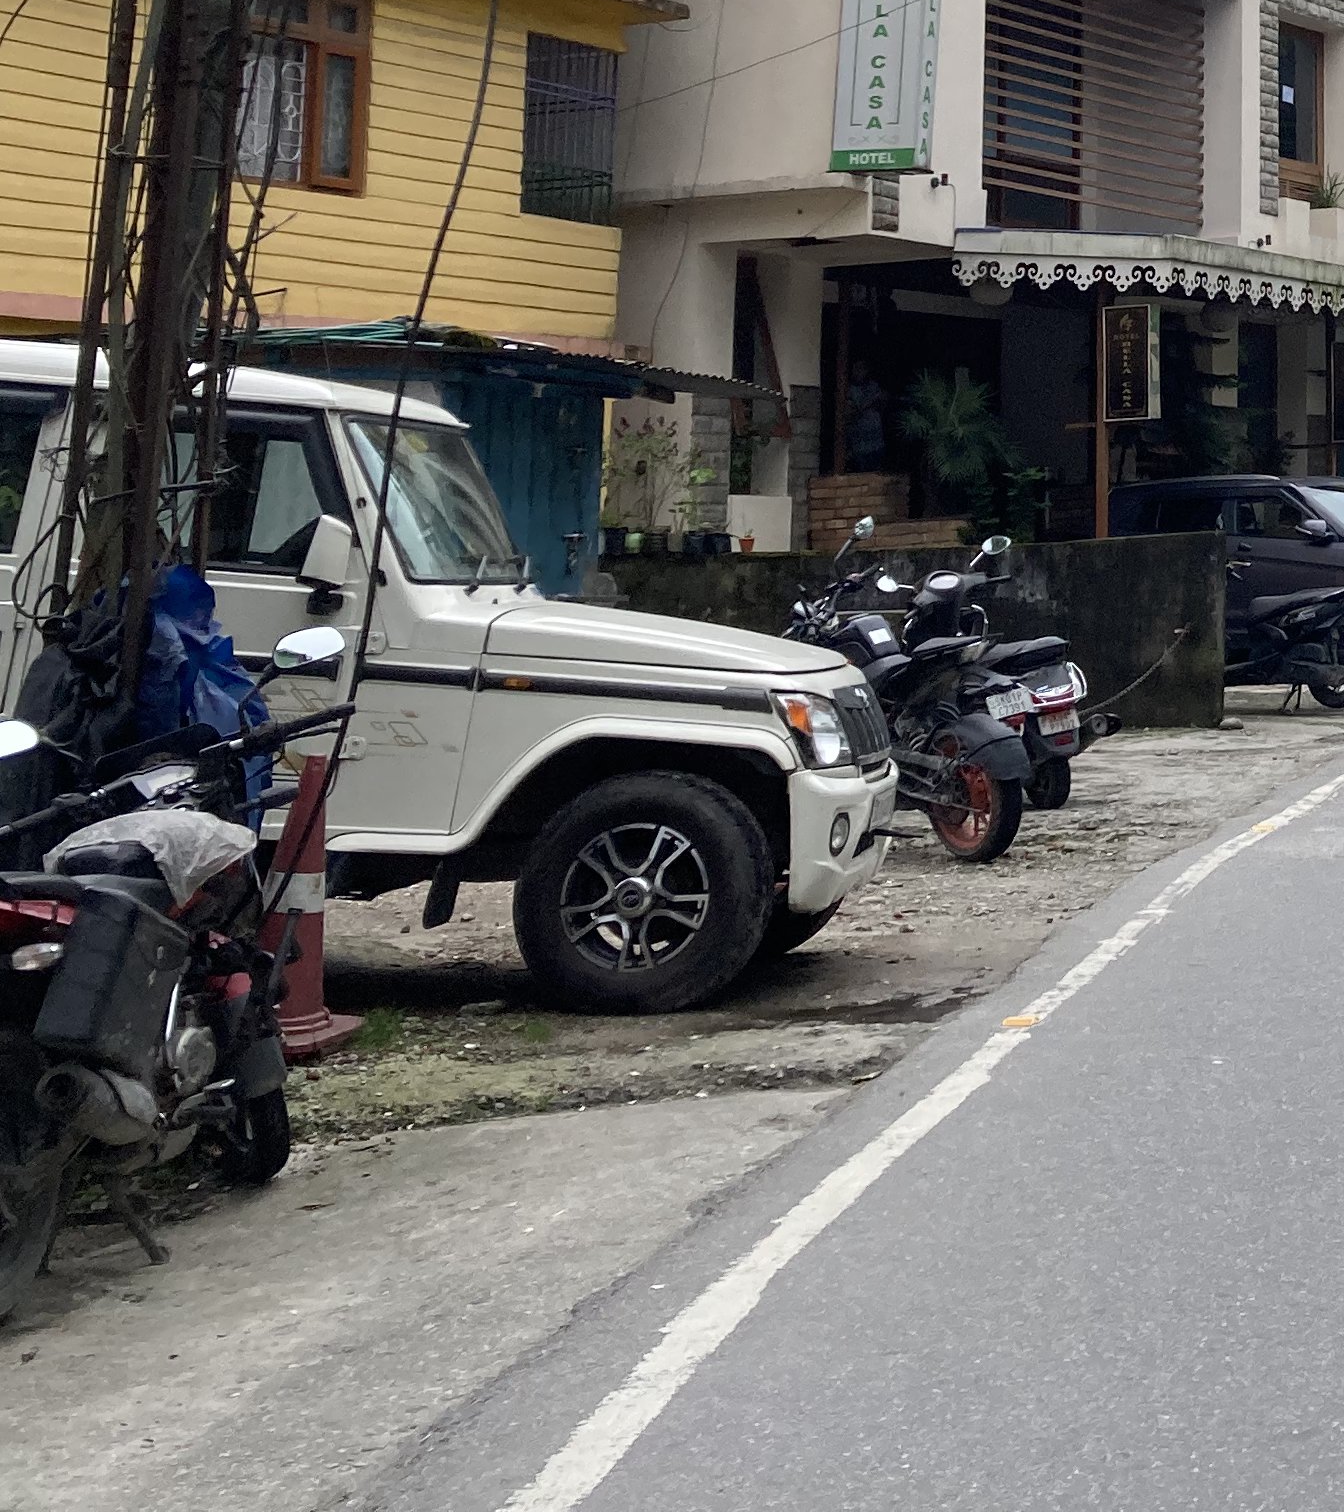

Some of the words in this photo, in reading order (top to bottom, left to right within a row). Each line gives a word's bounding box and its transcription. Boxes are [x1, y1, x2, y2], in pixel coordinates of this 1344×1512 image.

[866, 55, 886, 129] CASA
[920, 60, 933, 155] CASA
[849, 153, 895, 165] HOTEL
